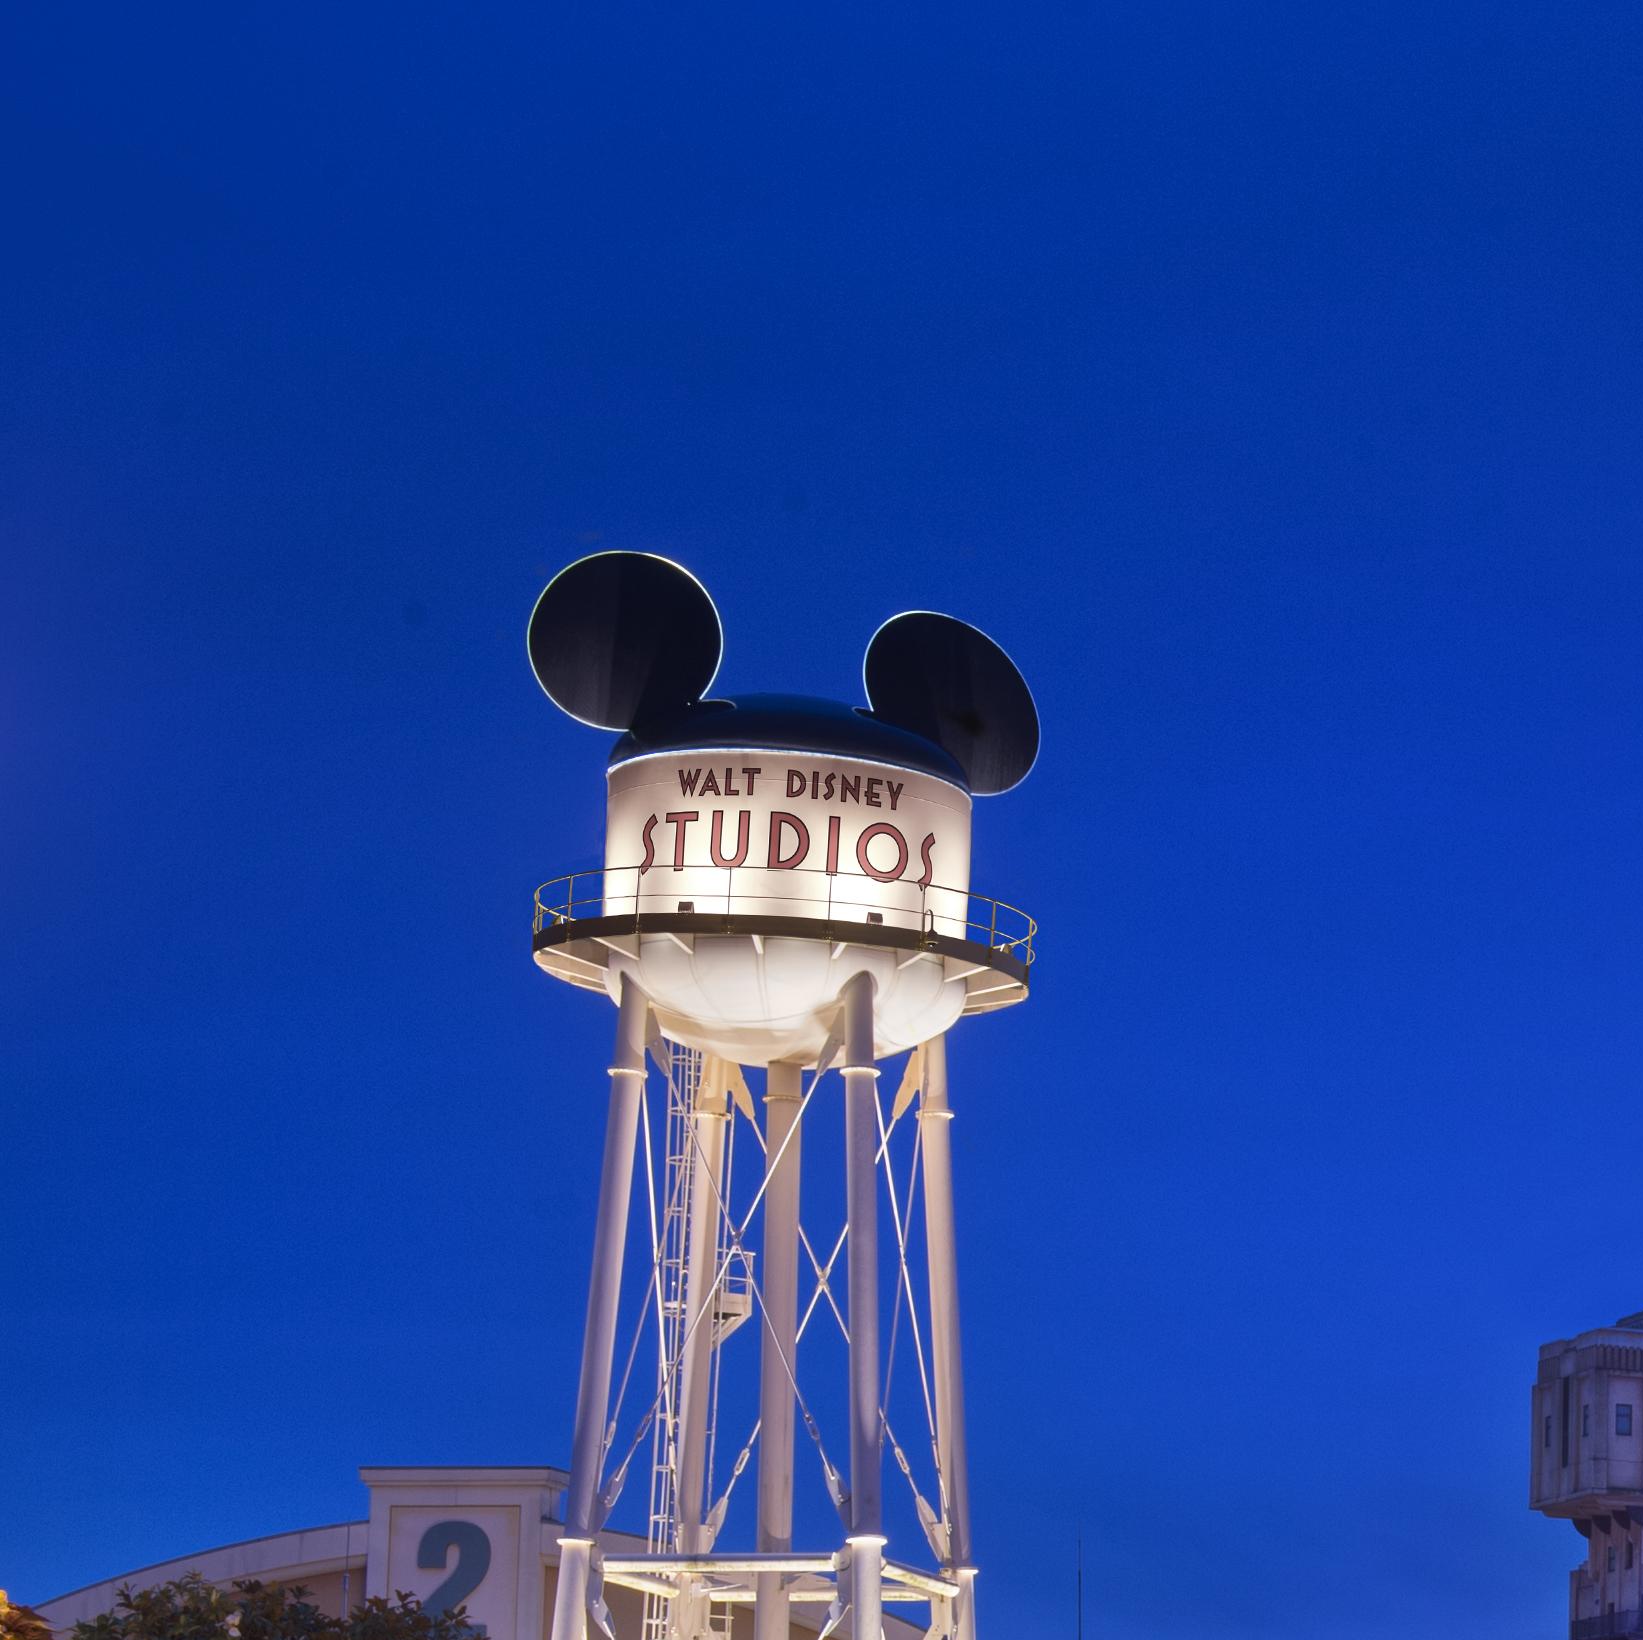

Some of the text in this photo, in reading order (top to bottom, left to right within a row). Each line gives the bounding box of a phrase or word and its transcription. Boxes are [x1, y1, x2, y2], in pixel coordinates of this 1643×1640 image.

[678, 767, 904, 811] WALT DISNEY
[640, 810, 936, 891] STUDIOS
